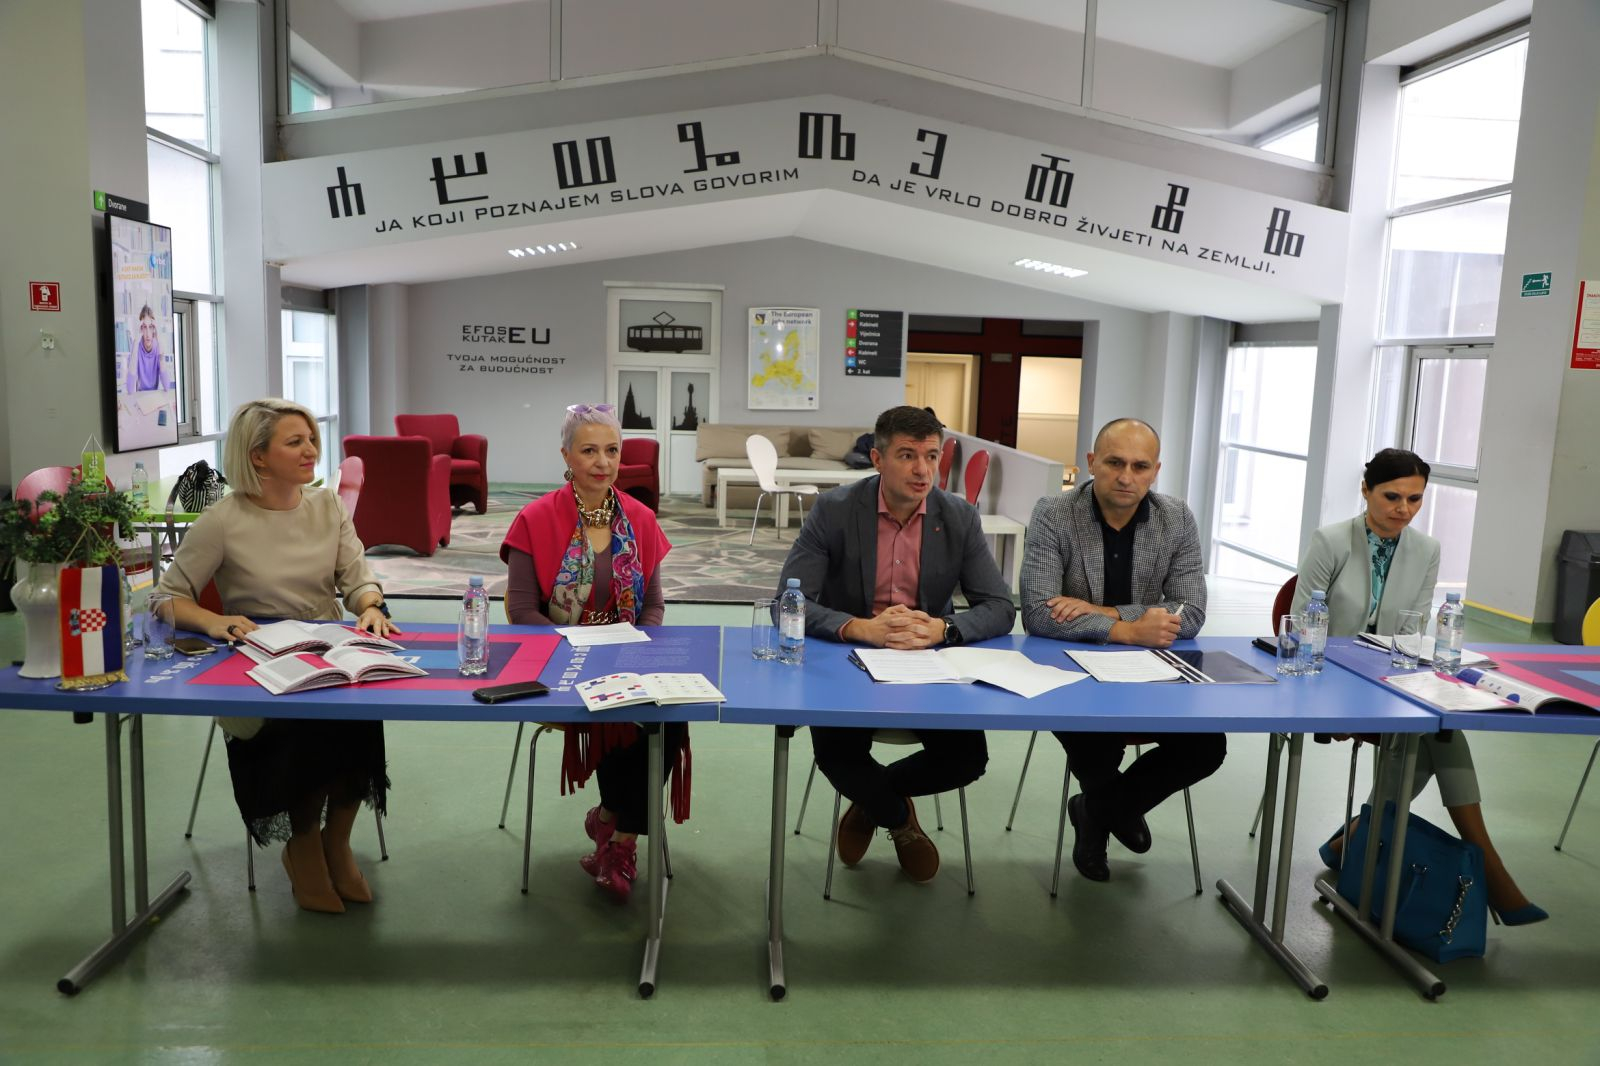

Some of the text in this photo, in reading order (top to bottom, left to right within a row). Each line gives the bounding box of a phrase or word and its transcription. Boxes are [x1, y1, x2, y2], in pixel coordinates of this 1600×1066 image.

[375, 168, 1276, 275] JA KOJI POZNAJEM SLOVA GOVORIM DA JE VRLO DOBRO ŽIVJETI NA ZEMLJI.
[462, 325, 507, 335] EFOS
[462, 335, 506, 343] KUTAK
[508, 327, 550, 344] EU
[447, 354, 485, 362] TVOJA
